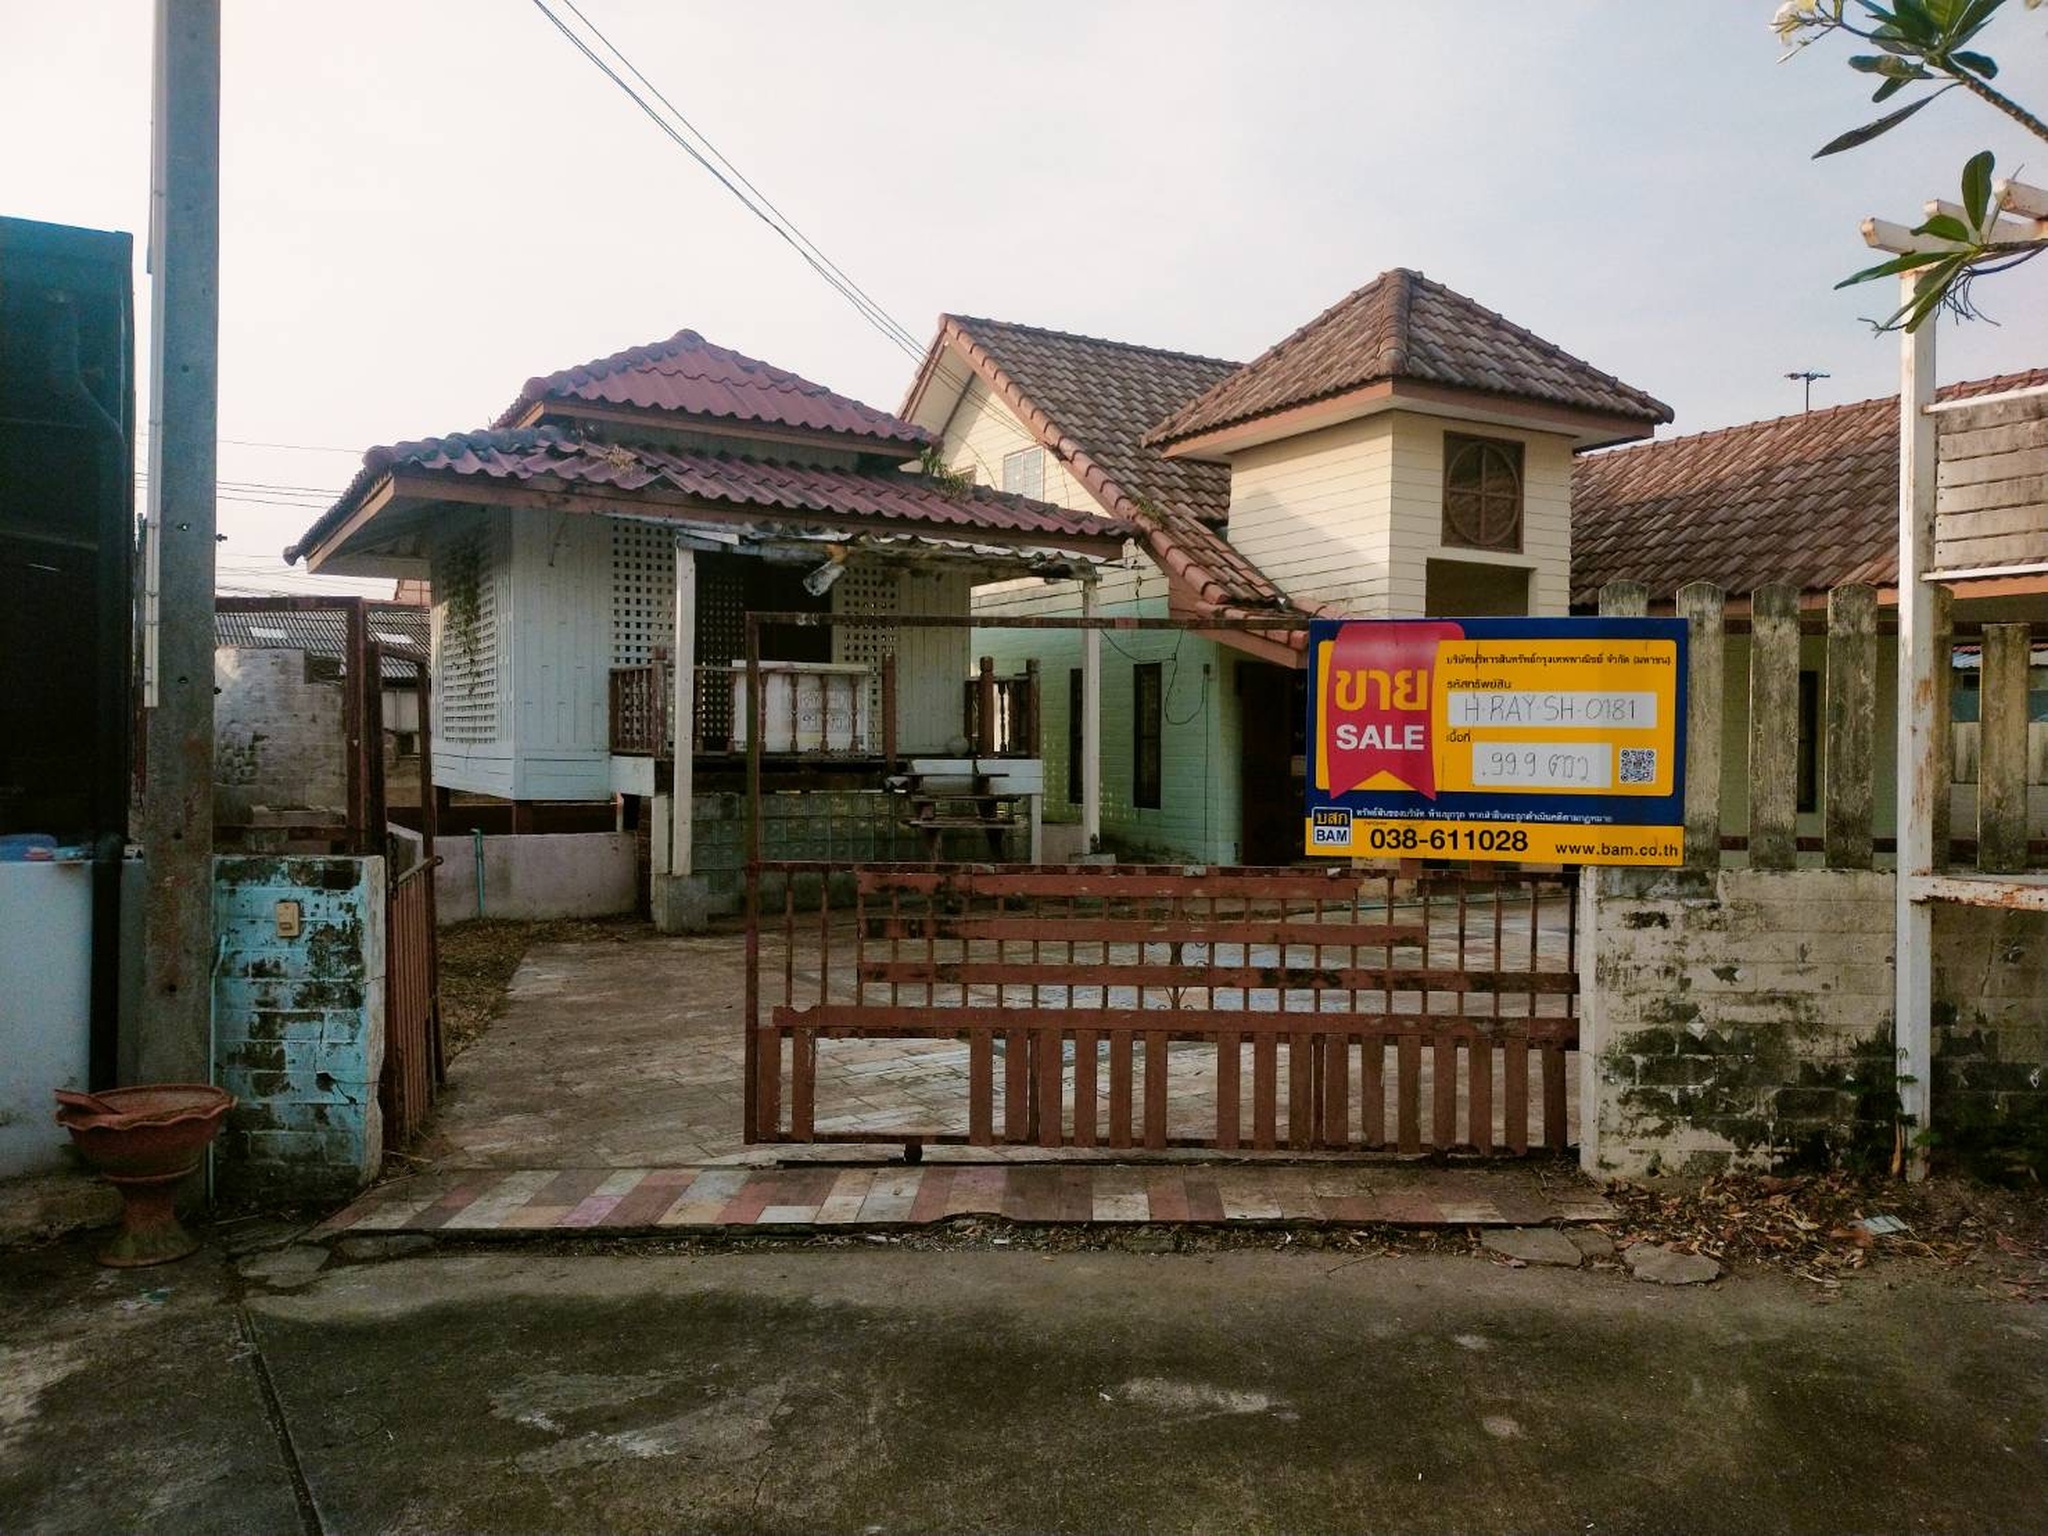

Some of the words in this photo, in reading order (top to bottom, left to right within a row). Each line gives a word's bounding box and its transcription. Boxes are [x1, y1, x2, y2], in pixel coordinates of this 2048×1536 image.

[1335, 669, 1428, 711] ขาย
[1336, 724, 1425, 750] SALE
[1316, 811, 1349, 826] บสก
[1316, 829, 1348, 843] BAM
[1370, 828, 1528, 852] 038-611028
[1555, 842, 1679, 857] www.bam.co.th
